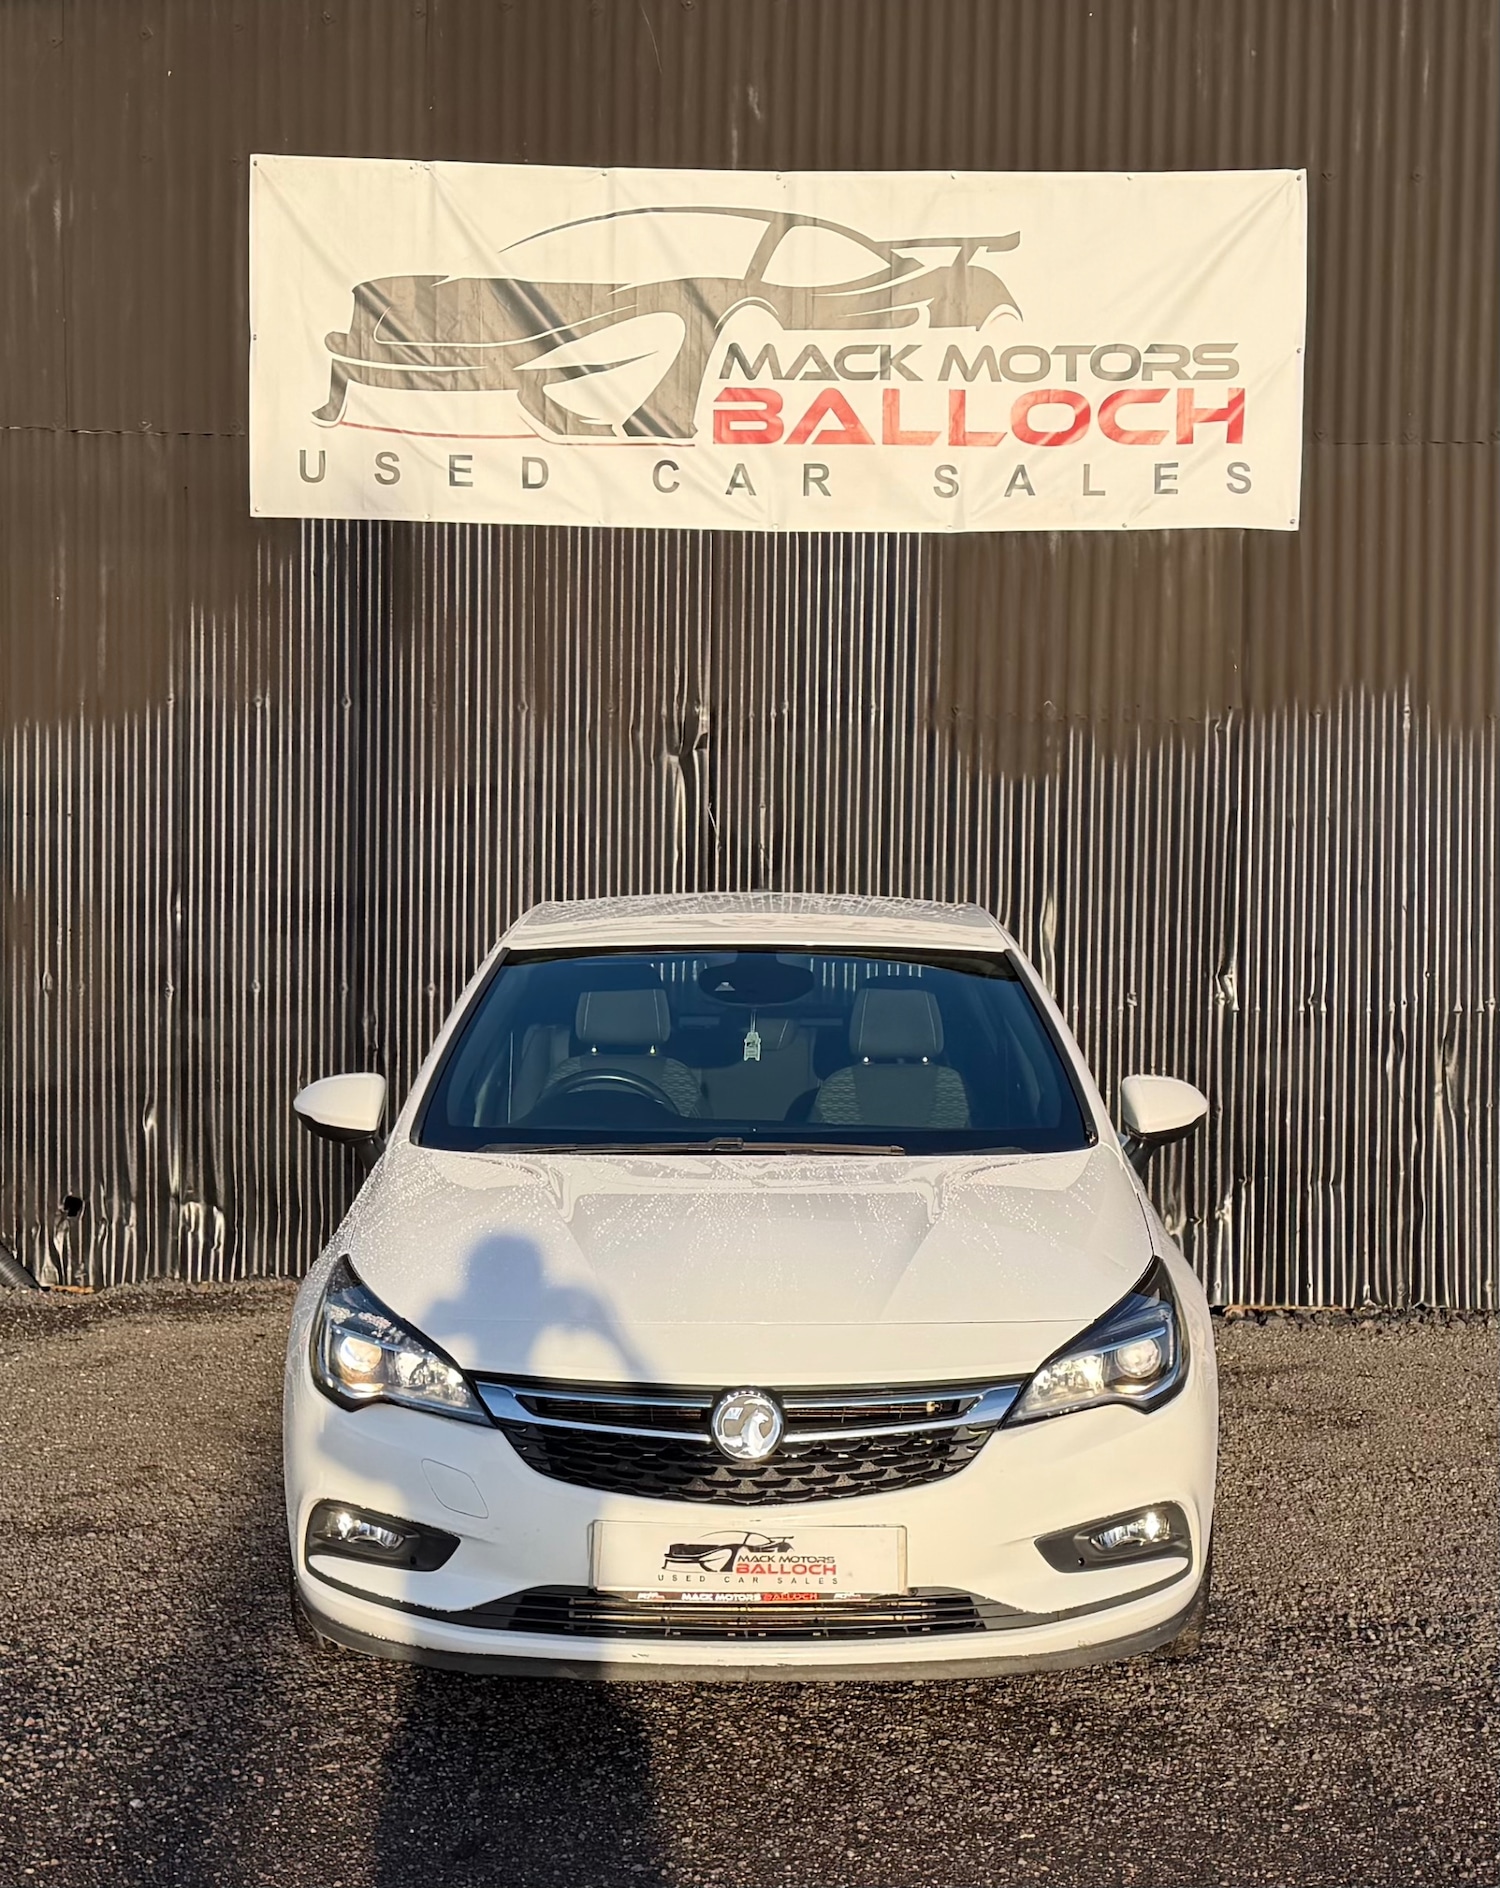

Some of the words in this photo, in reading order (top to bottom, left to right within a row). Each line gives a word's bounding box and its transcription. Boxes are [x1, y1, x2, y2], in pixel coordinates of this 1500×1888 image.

[718, 343, 923, 382] MACK
[937, 342, 1239, 382] MOTORS
[712, 386, 1245, 446] BALLOCH
[299, 448, 549, 490] USED
[652, 459, 831, 497] CAR
[933, 462, 1252, 498] SALES
[737, 1555, 776, 1563] MACK
[778, 1555, 836, 1564] MOTORS
[735, 1563, 837, 1575] BALLOCH
[657, 1574, 706, 1582] USED
[723, 1576, 759, 1584] CAR
[777, 1577, 838, 1585] SALES
[681, 1593, 714, 1601] MACK
[715, 1593, 761, 1601] MOTORS
[763, 1593, 818, 1602] BALLOCH
